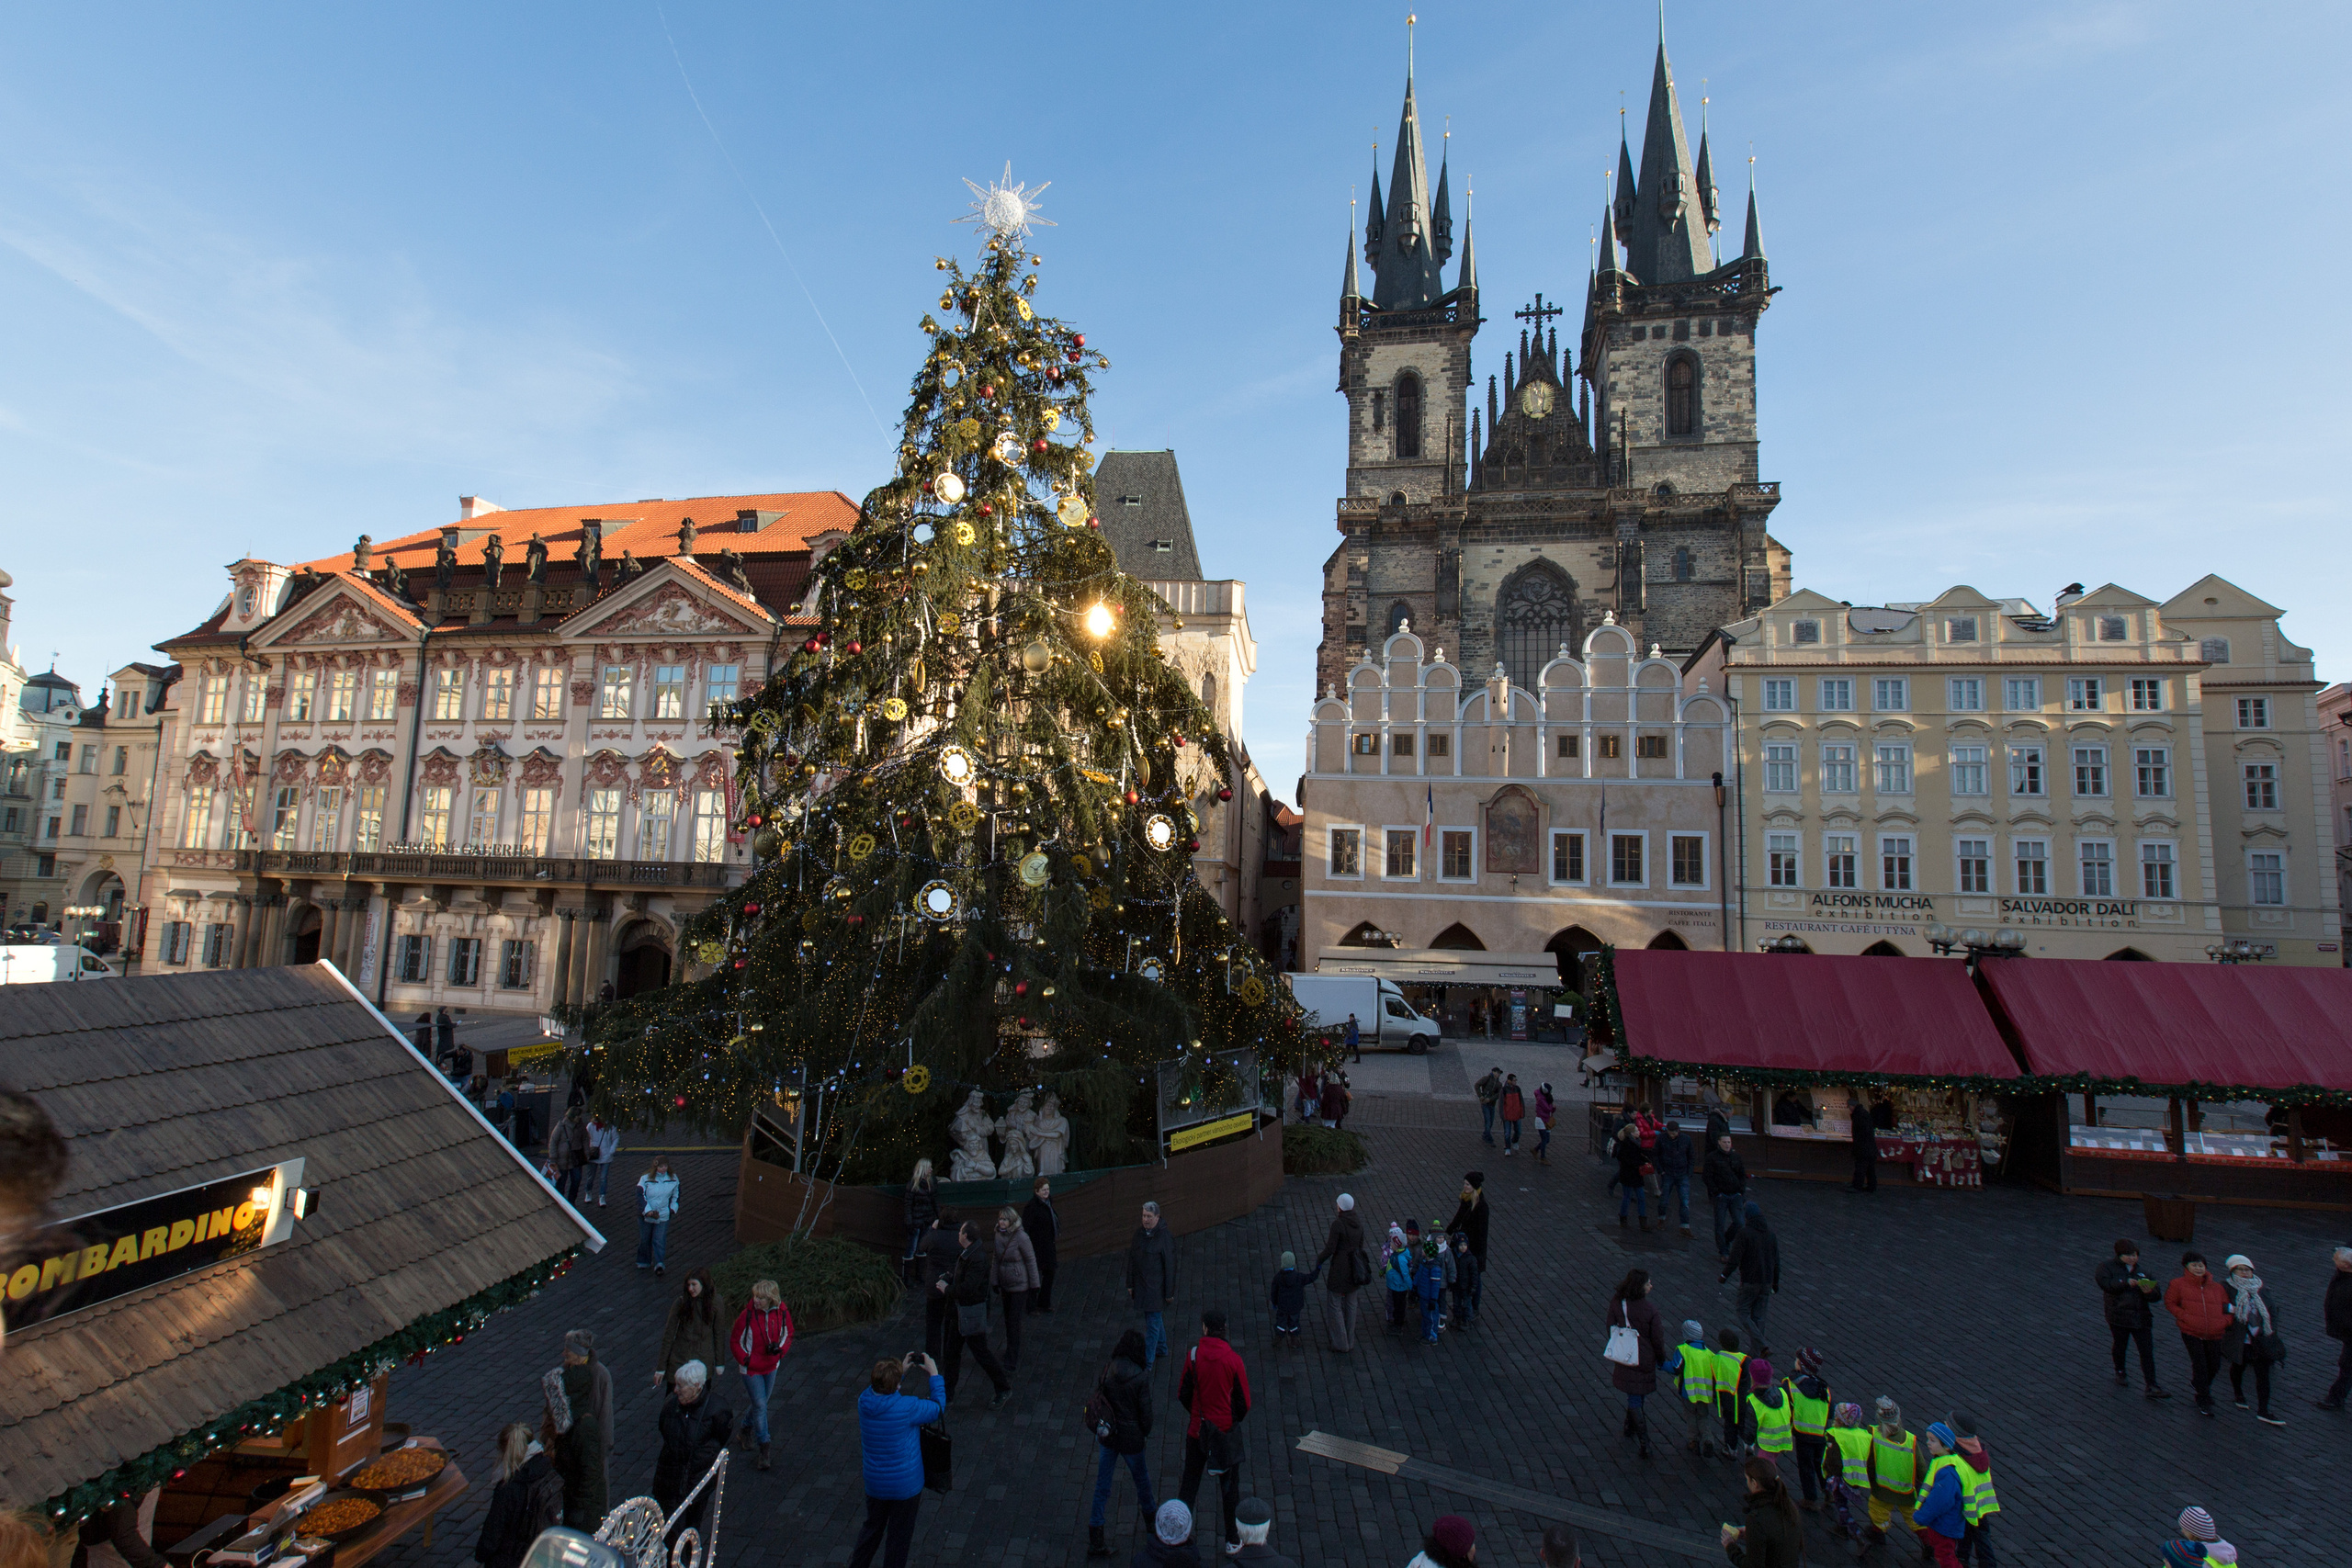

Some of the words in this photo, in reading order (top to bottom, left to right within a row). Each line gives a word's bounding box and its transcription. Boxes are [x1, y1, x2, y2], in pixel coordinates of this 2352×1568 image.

[387, 840, 456, 855] NÁRODNÍ
[1812, 894, 1871, 908] ALFONS
[1875, 897, 1933, 909] MUCHA
[2001, 899, 2090, 915] SALVADOR
[2097, 900, 2136, 916] DALÍ
[1815, 908, 1934, 921] exhibition
[2003, 915, 2135, 928] exhibition
[1764, 921, 1838, 932] RESTAURANT
[1840, 924, 1872, 933] CAFÉ
[1873, 926, 1881, 934] U
[1883, 924, 1917, 935] TÝNA
[0, 1201, 255, 1303] OMBARDINO
